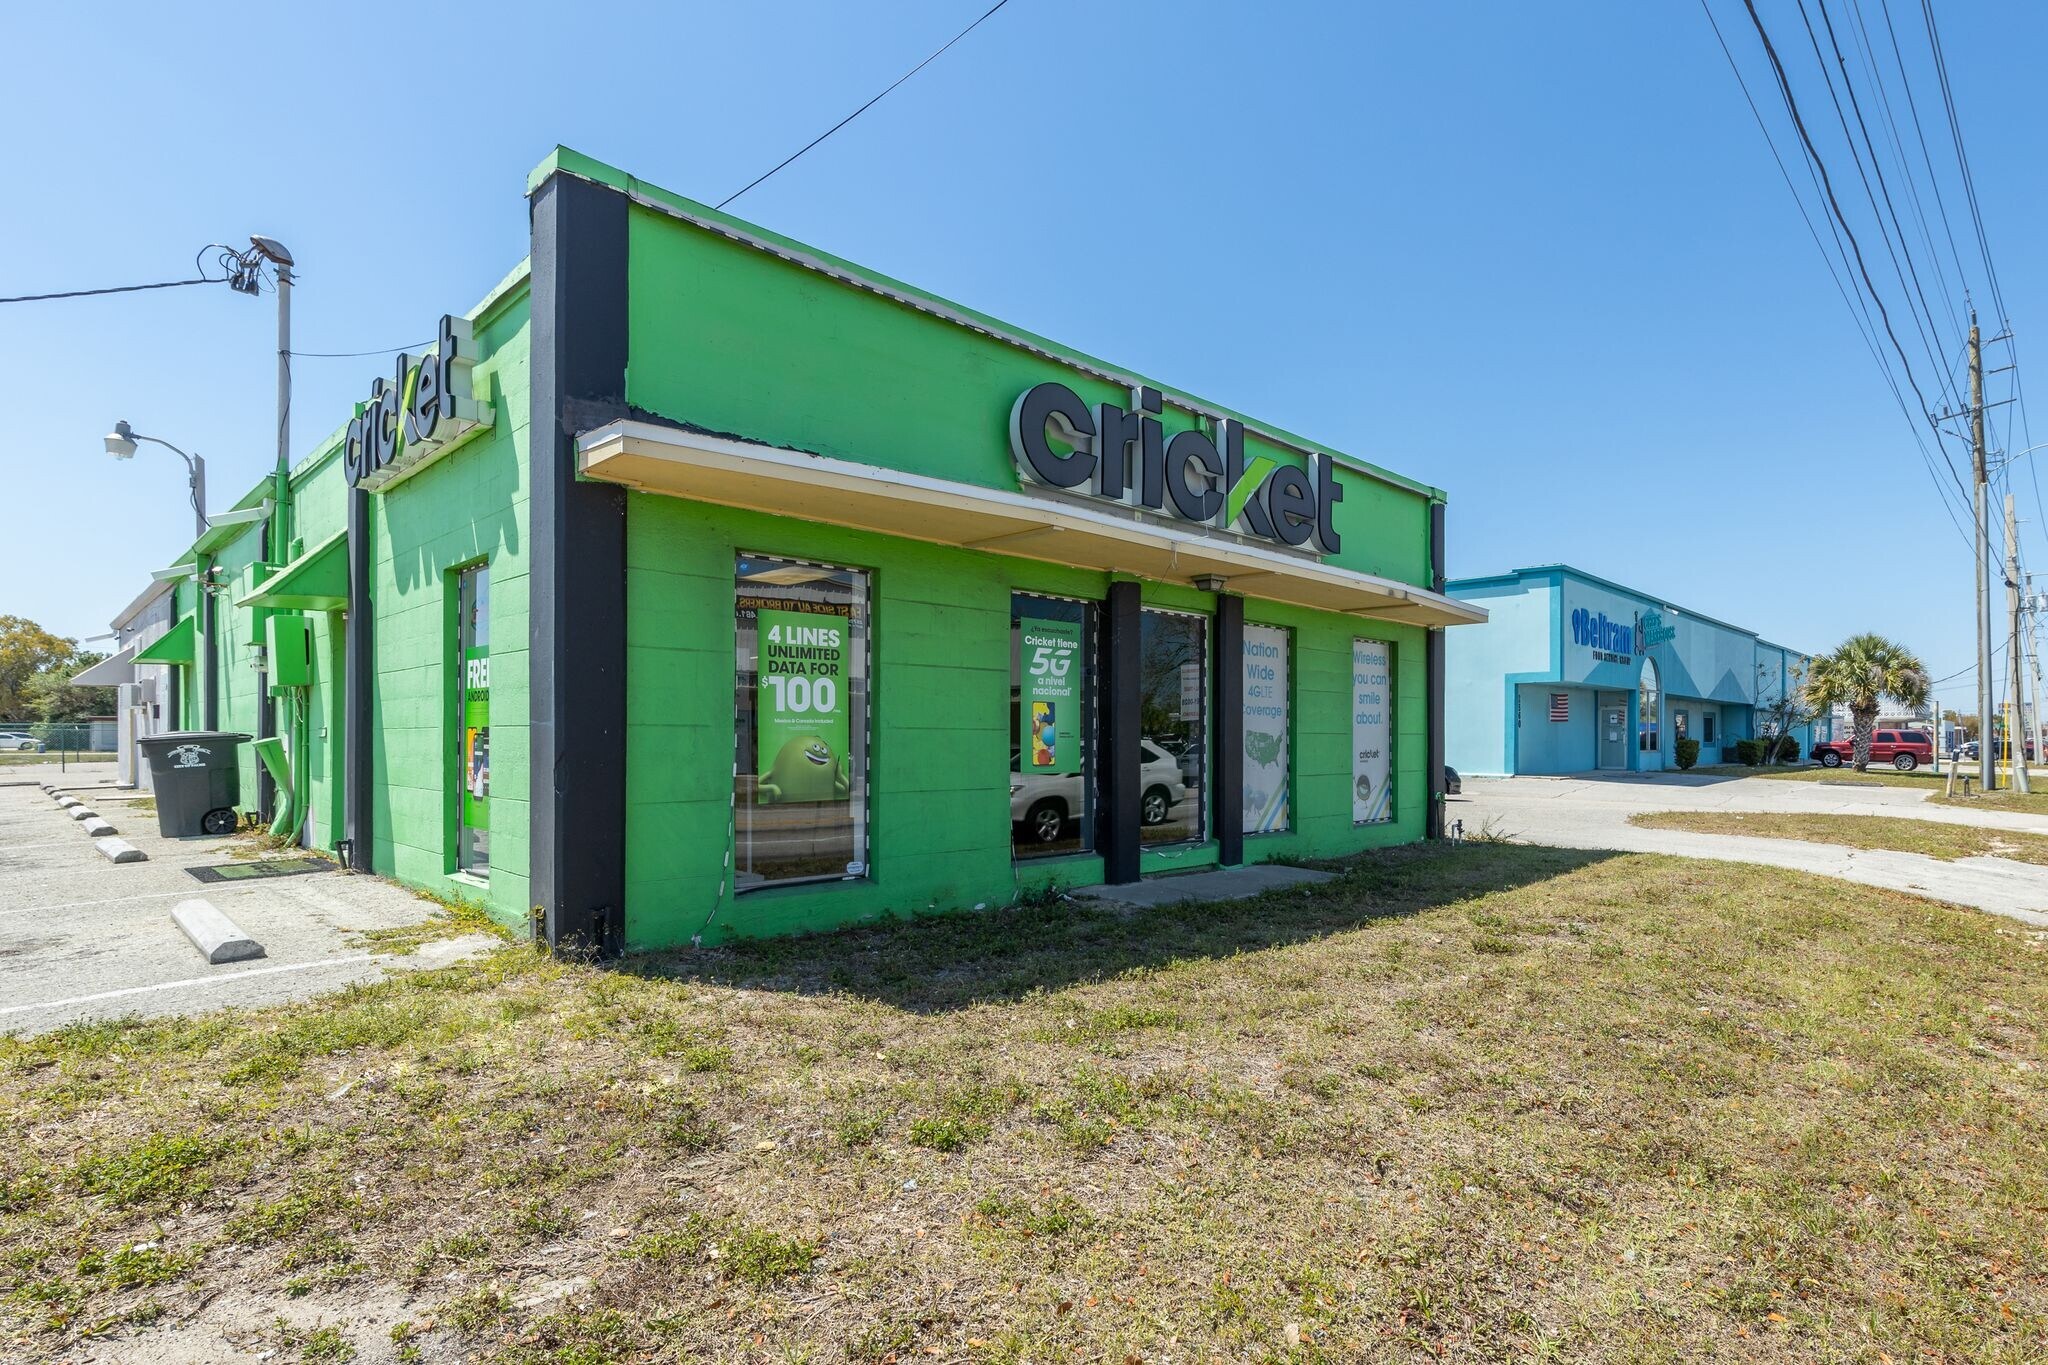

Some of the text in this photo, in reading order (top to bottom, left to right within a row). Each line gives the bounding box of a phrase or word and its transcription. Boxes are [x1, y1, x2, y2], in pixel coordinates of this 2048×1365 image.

[344, 314, 457, 488] cricket
[1011, 382, 1343, 555] cricket
[768, 625, 841, 648] 4 LINES
[1580, 608, 1632, 654] Beltram
[1024, 635, 1078, 649] Cricket tiene
[1243, 640, 1279, 658] Nation
[767, 645, 841, 661] UNLIMITED
[1353, 651, 1387, 667] Wireless
[768, 661, 839, 676] DATA FOR
[1029, 647, 1072, 677] 5G
[1246, 663, 1275, 680] Wide
[1037, 677, 1065, 686] a nivel
[1353, 673, 1387, 687] you can
[761, 676, 836, 713] $100
[1358, 692, 1381, 705] smile
[1243, 703, 1282, 719] overage
[1359, 748, 1379, 759] cricket
